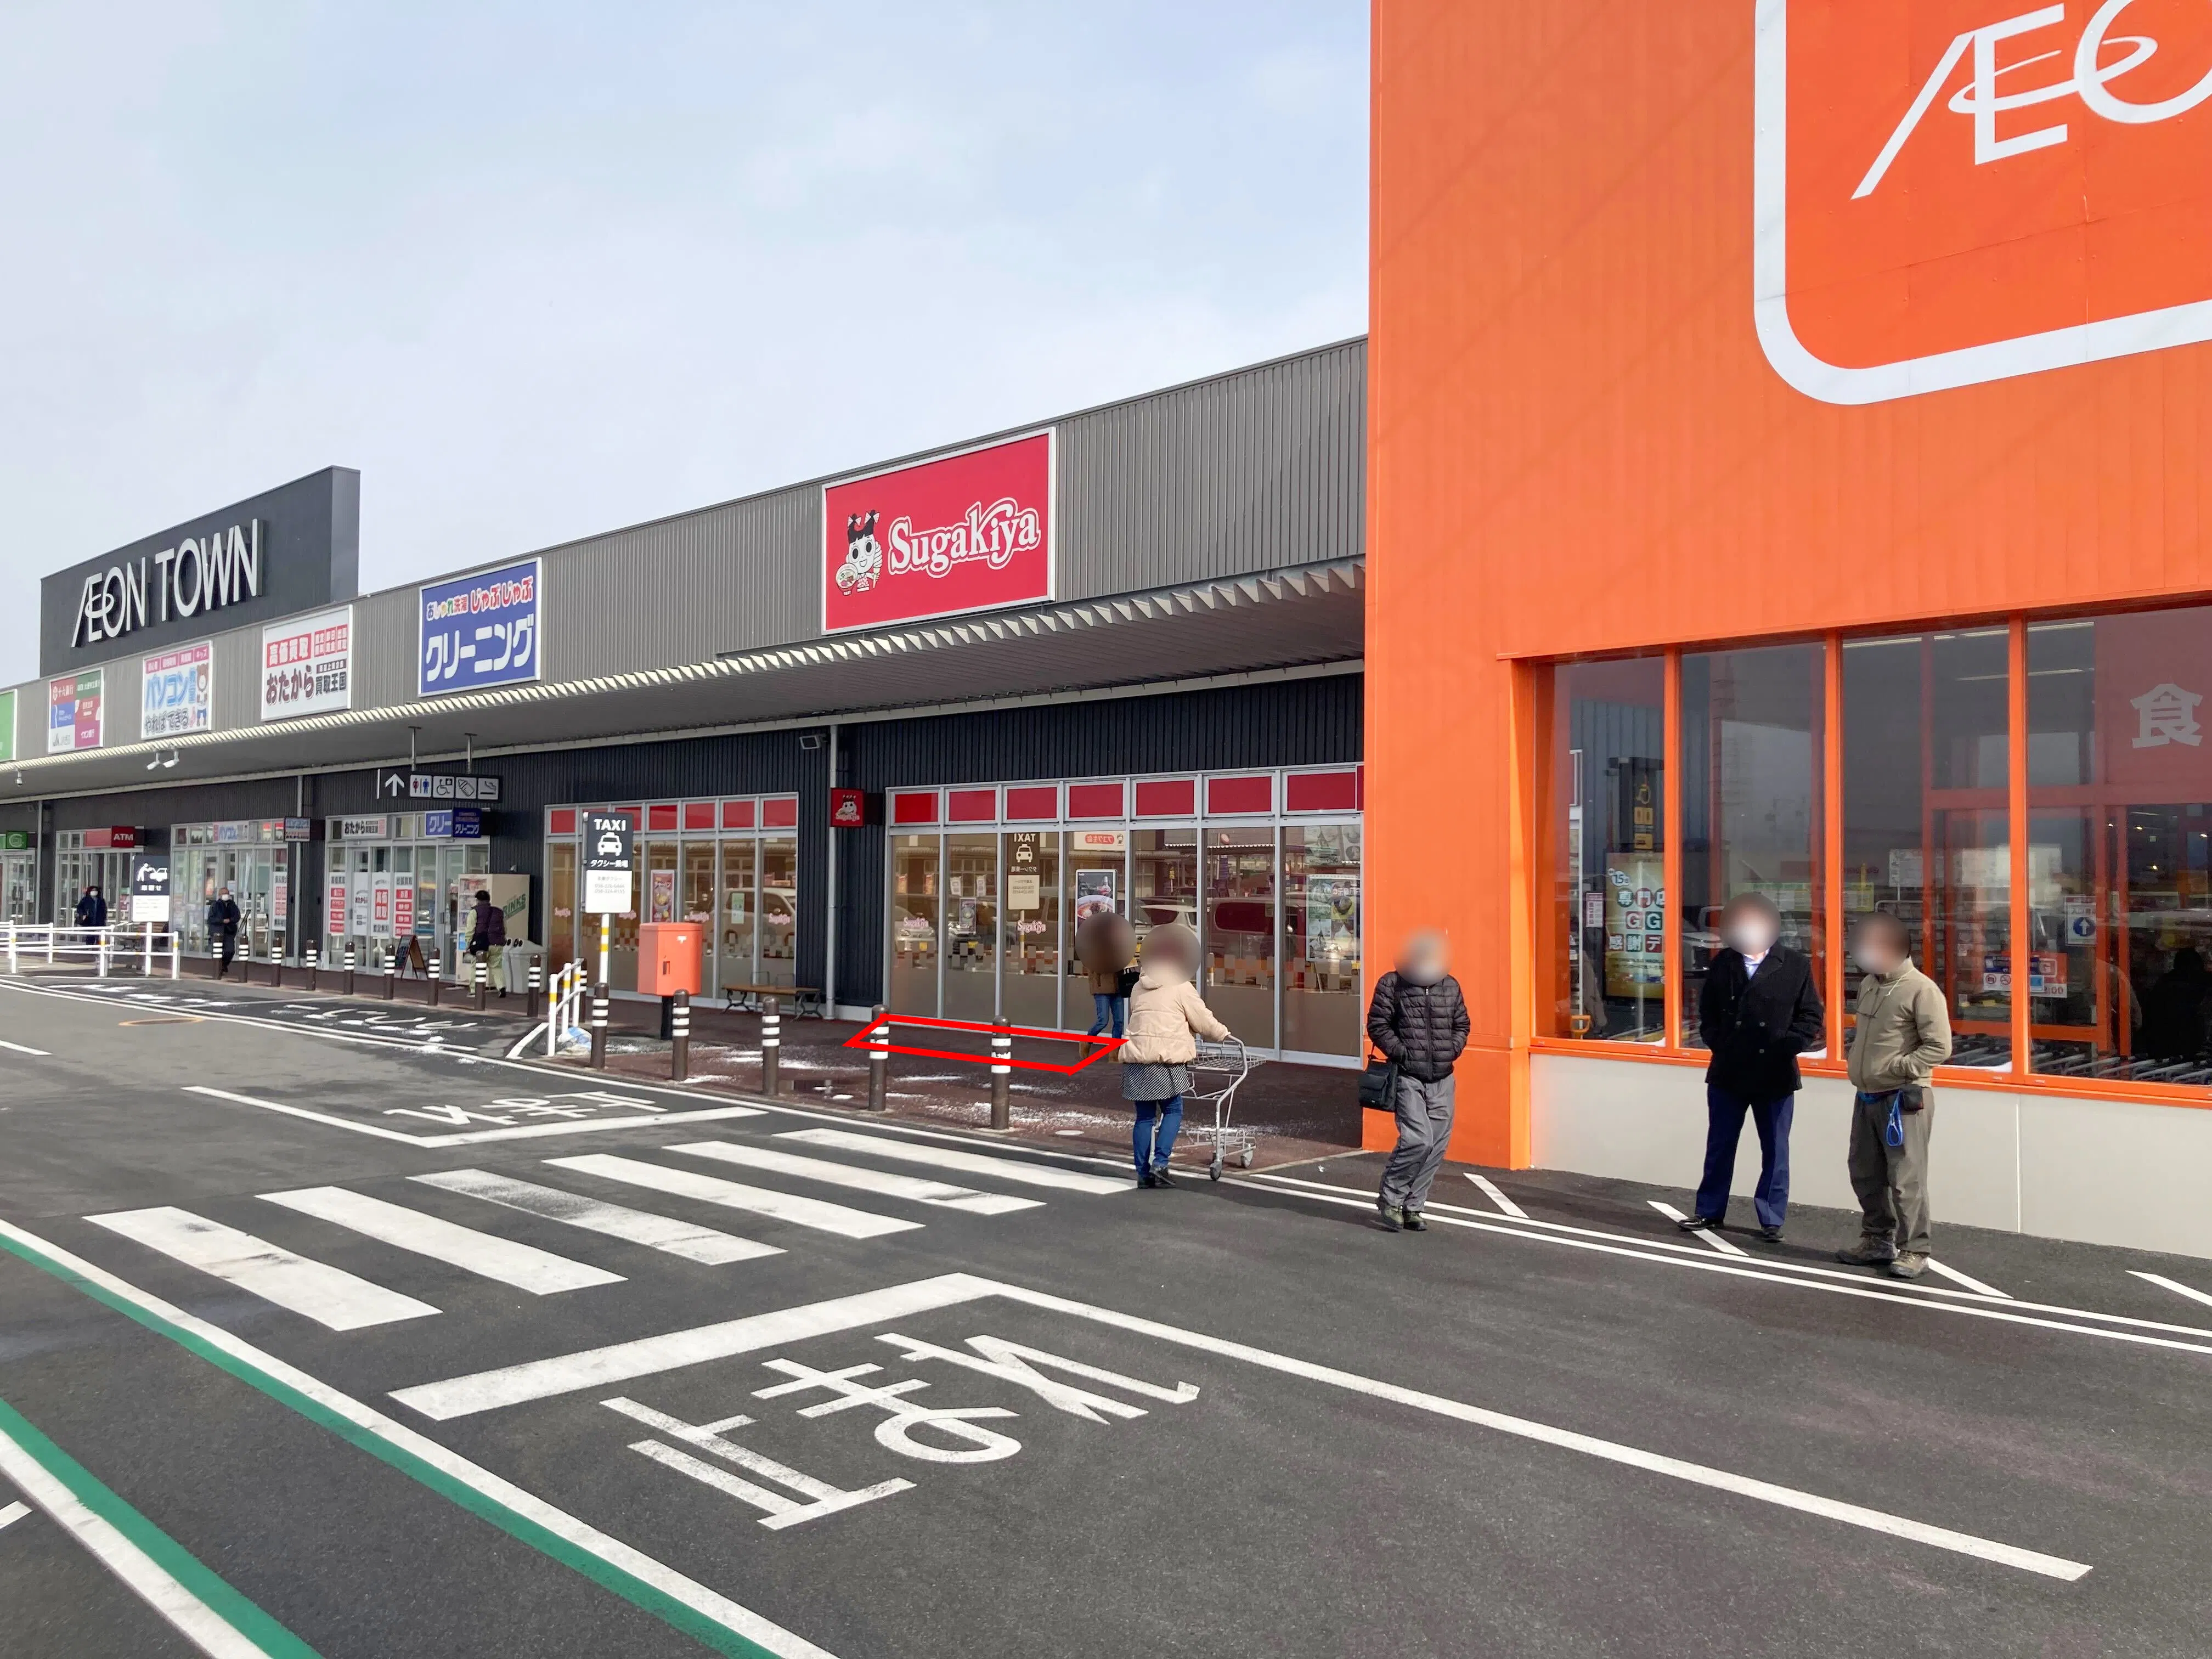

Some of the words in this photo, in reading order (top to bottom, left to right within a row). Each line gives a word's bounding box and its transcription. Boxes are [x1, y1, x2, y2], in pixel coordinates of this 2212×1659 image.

[889, 498, 1040, 577] Sugakiya
[155, 518, 258, 621] TOWN
[426, 613, 534, 682] クリーニング
[266, 664, 314, 706] おたから
[594, 819, 627, 831] TAXI
[503, 893, 526, 915] RINKS
[1017, 919, 1046, 934] Sugakiya
[383, 1091, 669, 1125] 止まれ
[600, 1333, 1200, 1530] 止まれ
